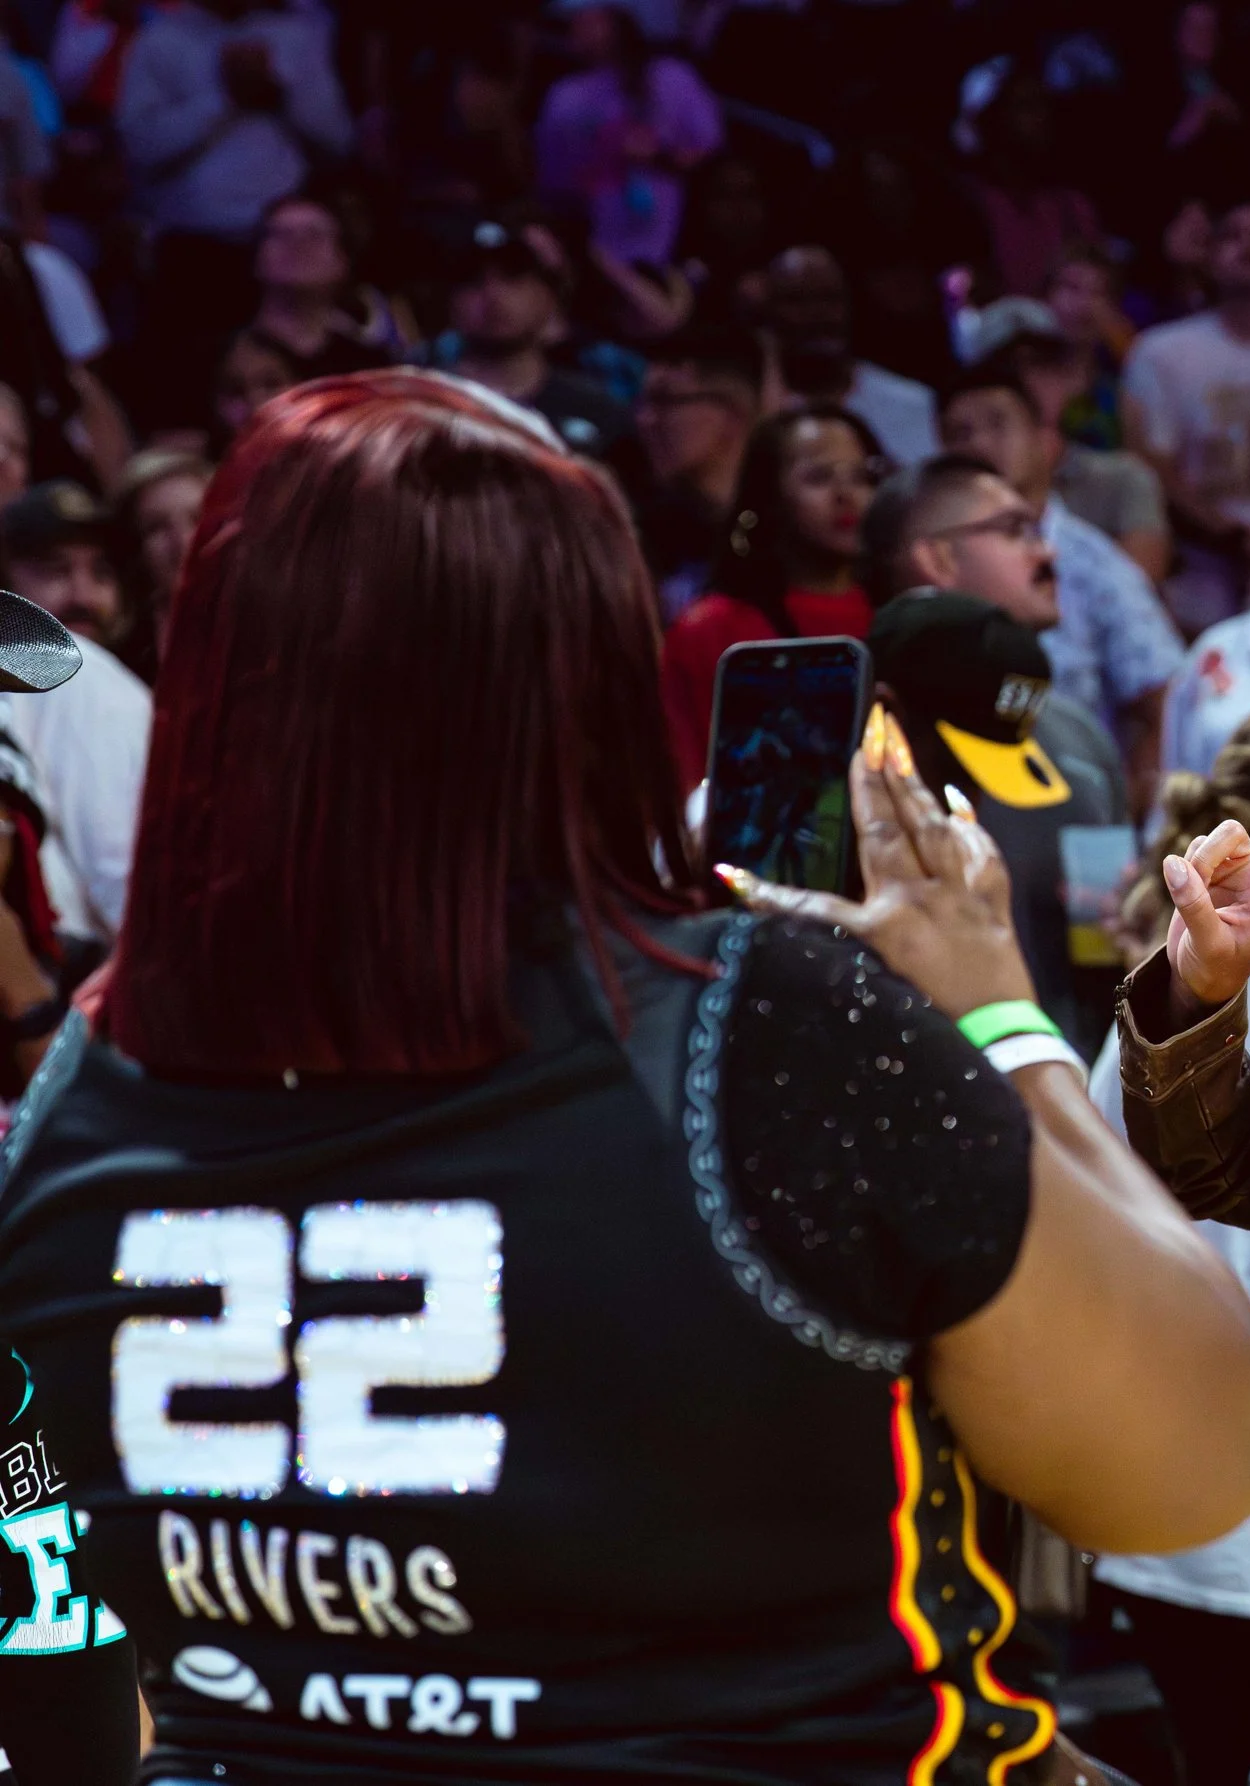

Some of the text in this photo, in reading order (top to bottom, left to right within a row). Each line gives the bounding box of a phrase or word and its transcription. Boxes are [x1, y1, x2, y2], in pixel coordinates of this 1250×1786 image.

[111, 1199, 507, 1496] 22
[159, 1509, 473, 1639] RIVERS
[300, 1672, 543, 1741] AT&T
